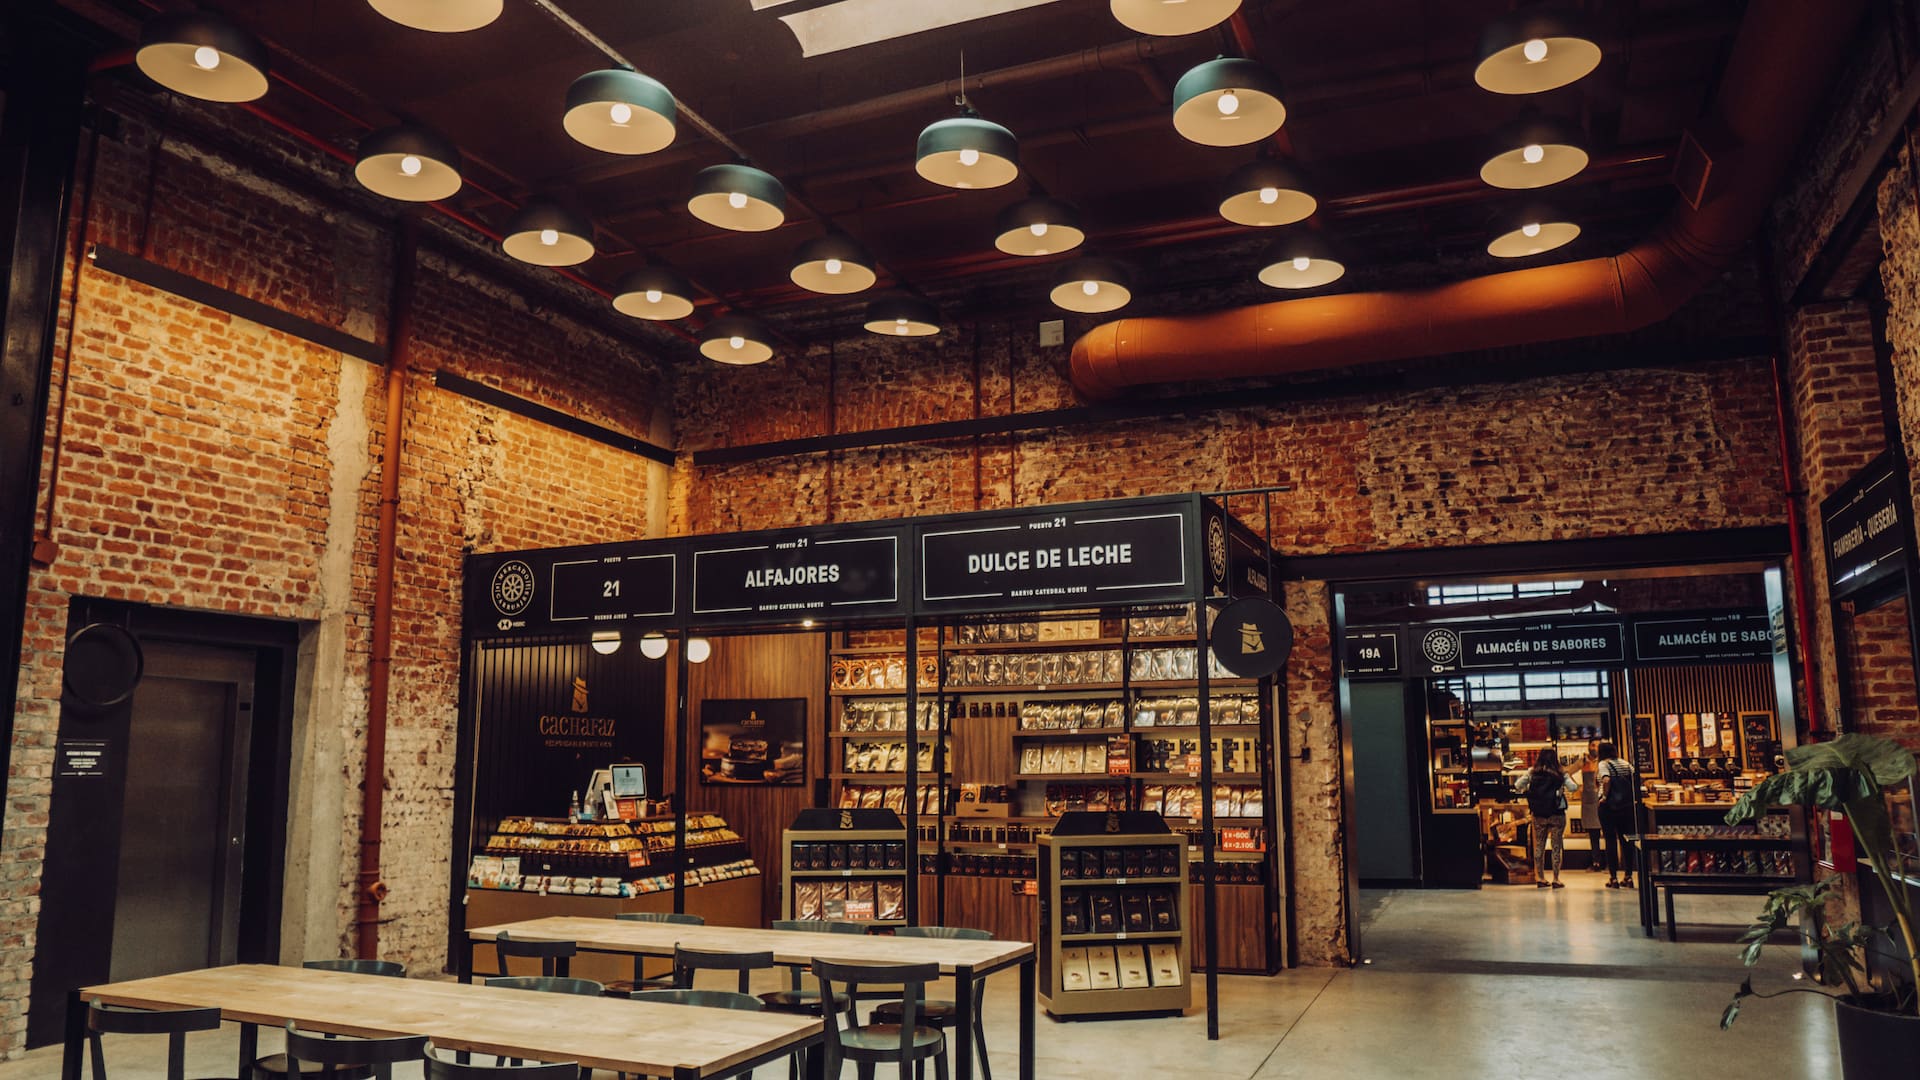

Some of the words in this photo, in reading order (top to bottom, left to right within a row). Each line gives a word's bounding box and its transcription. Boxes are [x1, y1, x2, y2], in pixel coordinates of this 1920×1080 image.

[1029, 522, 1052, 530] PUERTO
[1054, 517, 1066, 528] 21
[1867, 498, 1898, 540] QUESERÍA
[797, 538, 808, 548] 21
[968, 551, 1030, 574] DULCE
[1036, 548, 1062, 568] DE
[1068, 544, 1132, 566] LECHE
[745, 564, 840, 588] ALFAJORES
[603, 580, 620, 597] 21
[1035, 588, 1066, 596] CATEDRAL
[1476, 640, 1529, 654] ALMACÉN
[1533, 640, 1548, 652] DE
[1552, 638, 1606, 650] SABORES
[1658, 630, 1717, 646] ALMACÉN
[1720, 632, 1737, 642] DE
[1360, 648, 1381, 659] 19A
